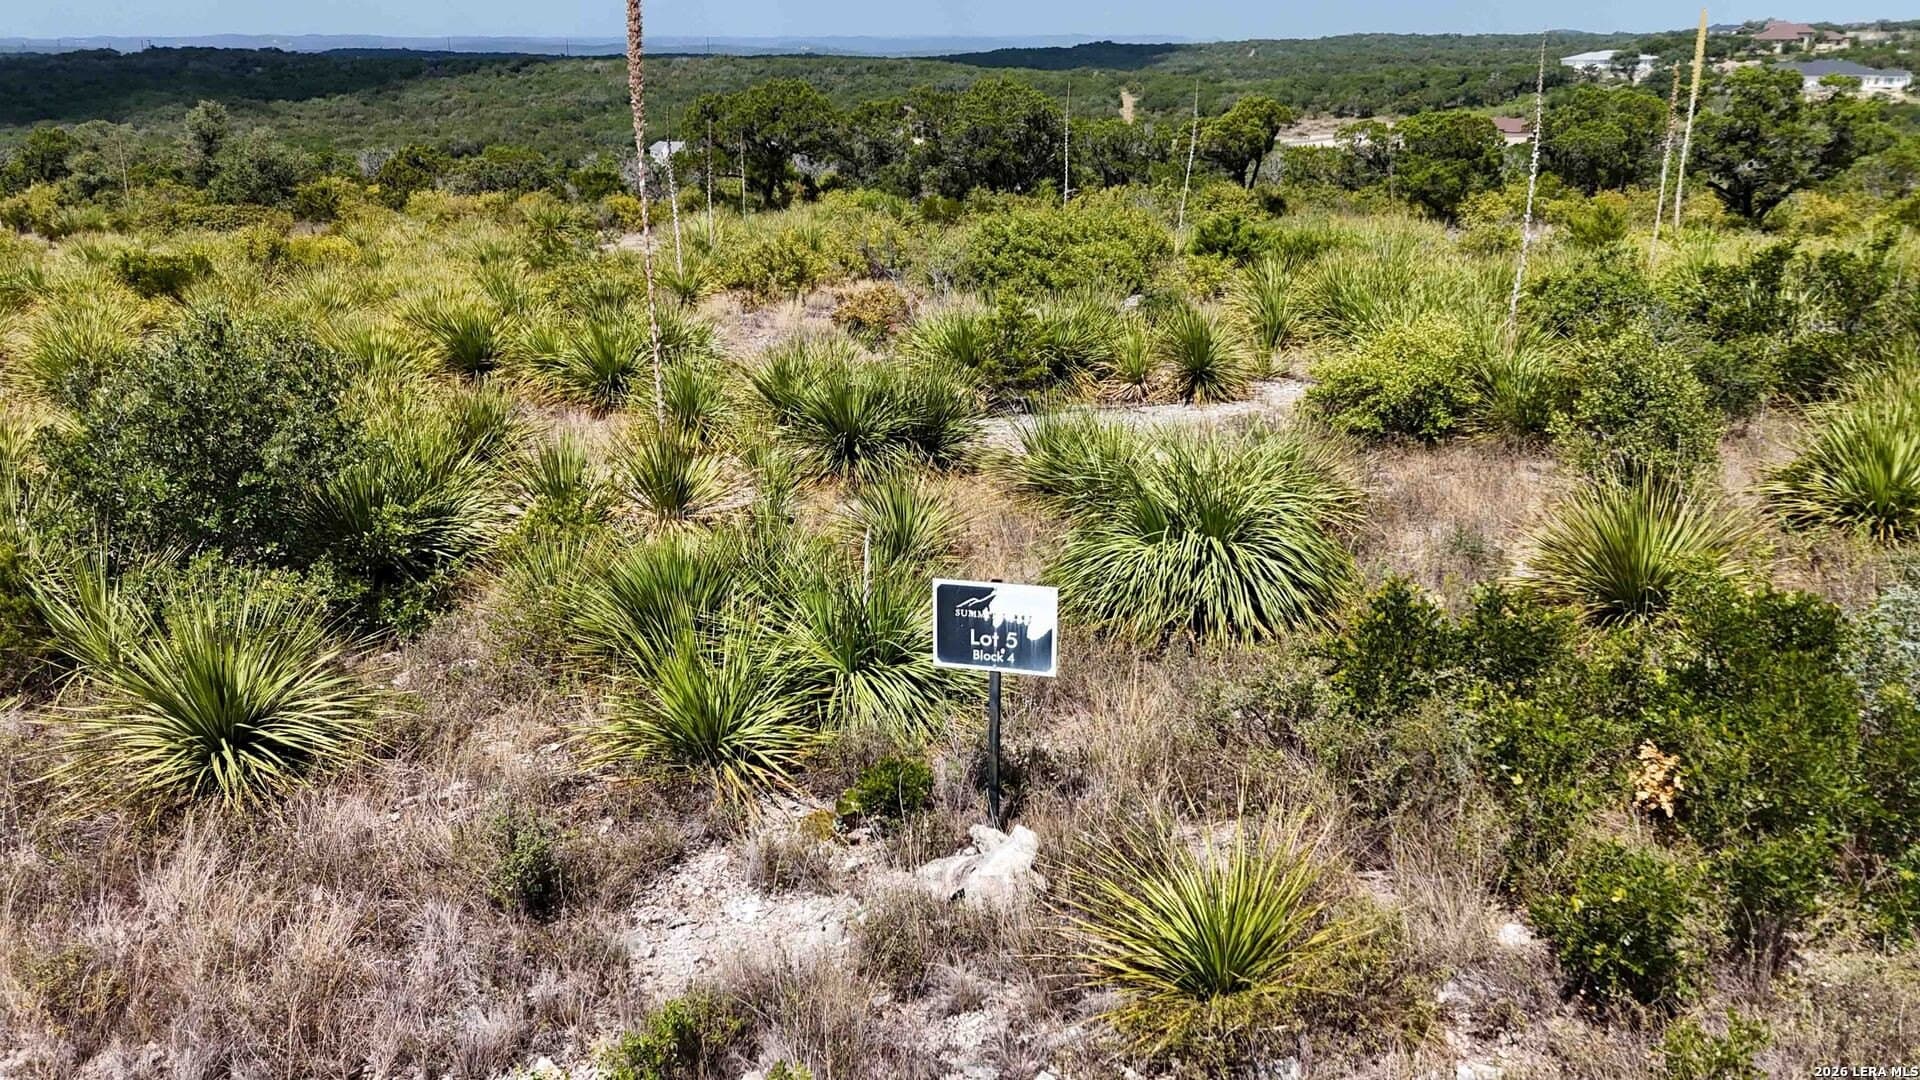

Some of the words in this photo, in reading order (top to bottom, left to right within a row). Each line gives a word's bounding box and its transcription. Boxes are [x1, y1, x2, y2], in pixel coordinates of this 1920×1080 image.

[954, 609, 992, 619] SUMM
[970, 629, 999, 647] Lot
[1005, 632, 1018, 648] 5
[973, 649, 1004, 662] Block
[1007, 653, 1015, 663] 4
